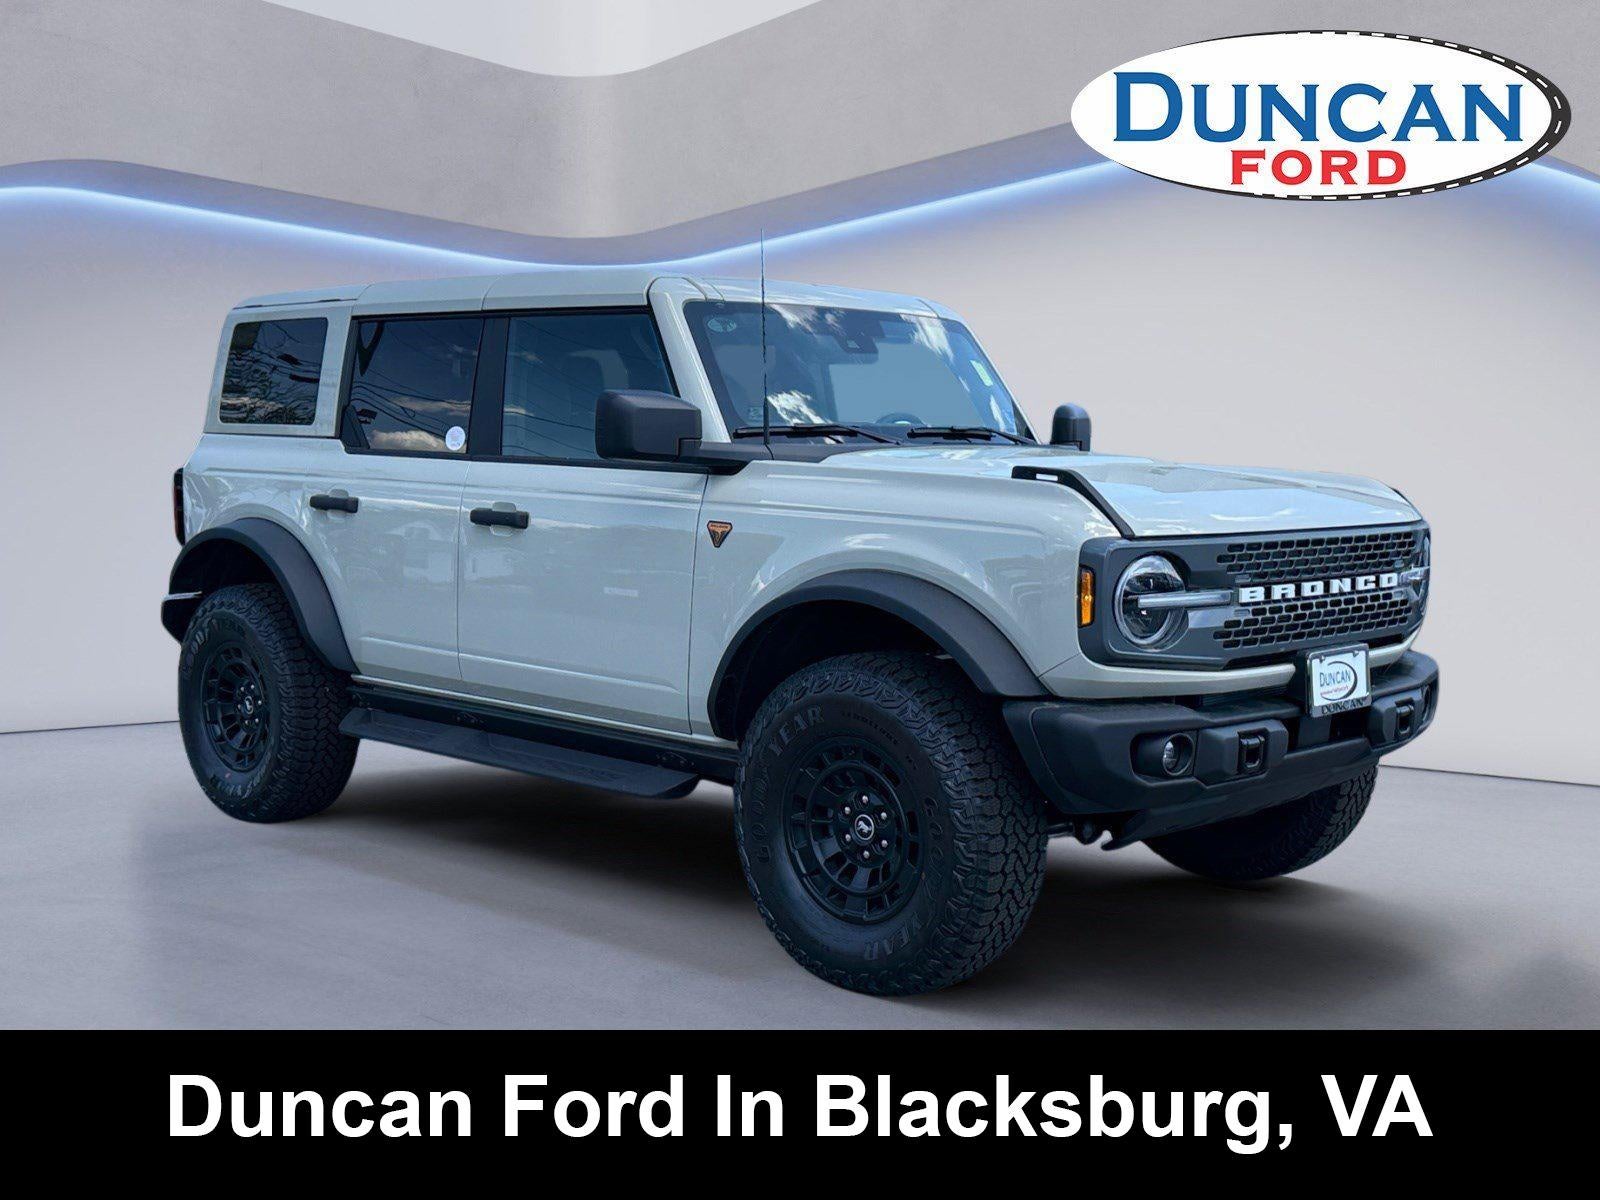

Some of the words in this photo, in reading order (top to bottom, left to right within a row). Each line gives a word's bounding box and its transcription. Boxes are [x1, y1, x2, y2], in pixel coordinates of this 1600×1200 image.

[1238, 573, 1398, 603] BRONCO
[1319, 669, 1351, 688] DUNCAN
[1321, 698, 1364, 715] DUNCAN
